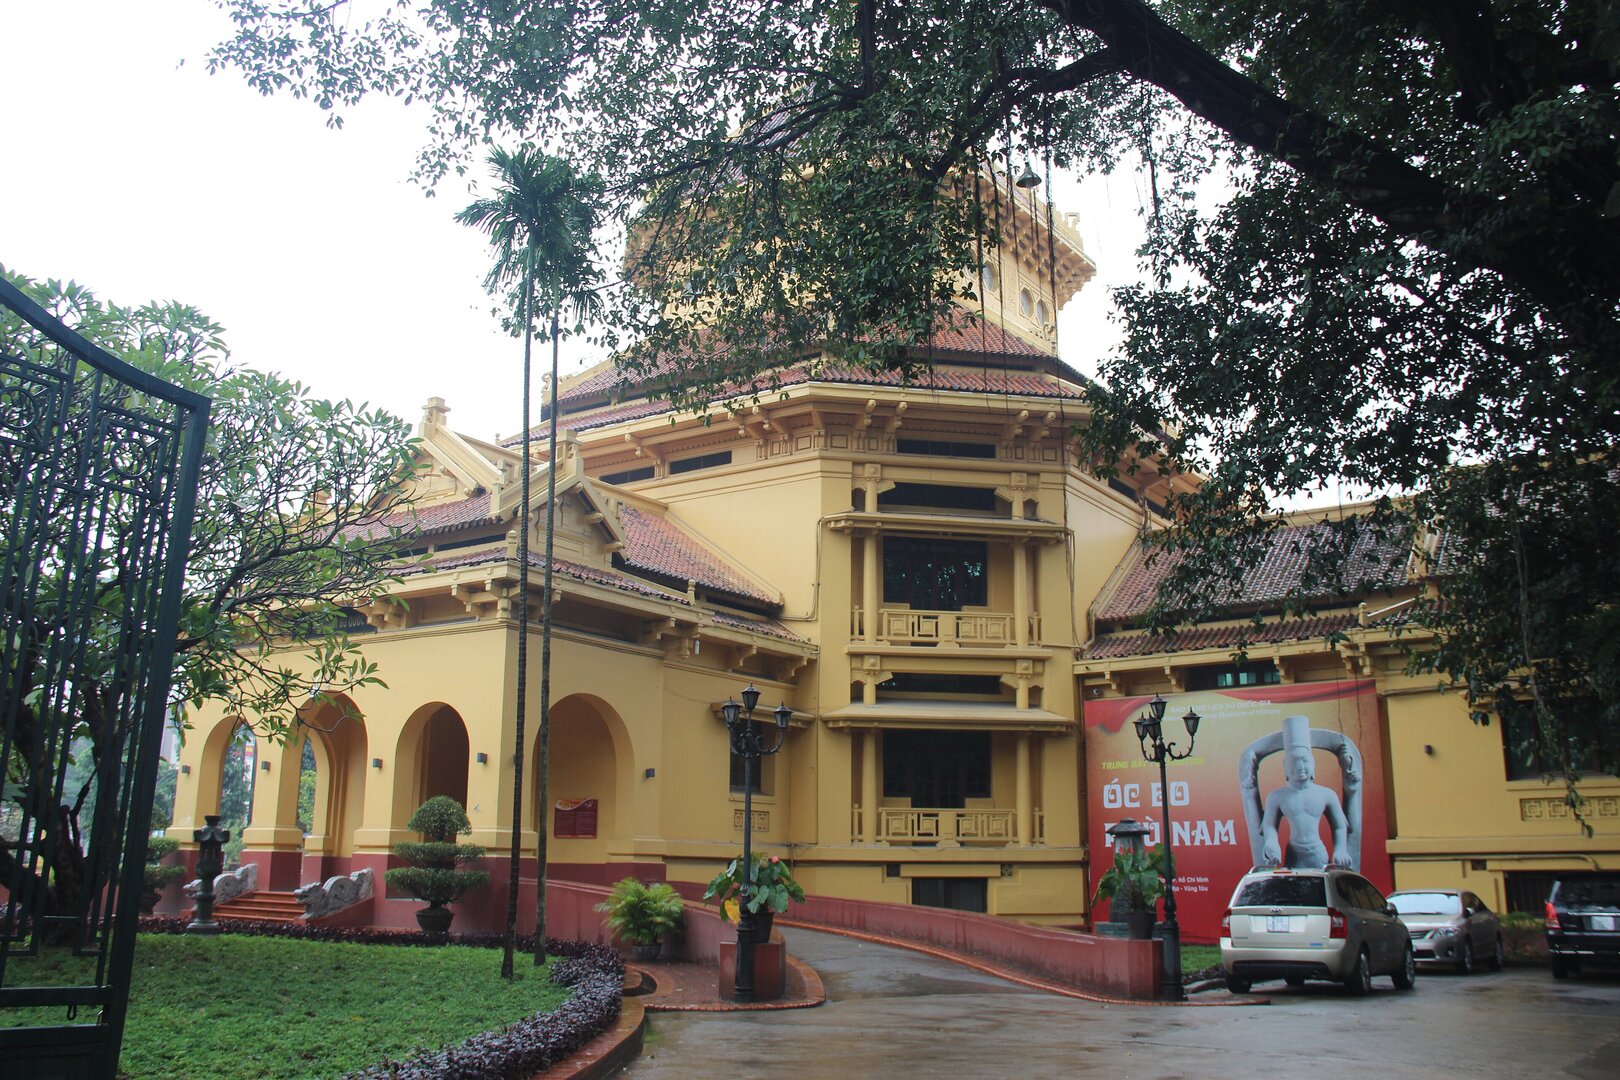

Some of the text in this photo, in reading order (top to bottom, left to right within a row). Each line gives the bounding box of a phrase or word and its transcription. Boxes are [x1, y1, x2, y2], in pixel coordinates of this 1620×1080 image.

[1102, 760, 1128, 770] TRUNG
[1103, 778, 1190, 809] ÓC EO
[1172, 819, 1237, 847] NAM
